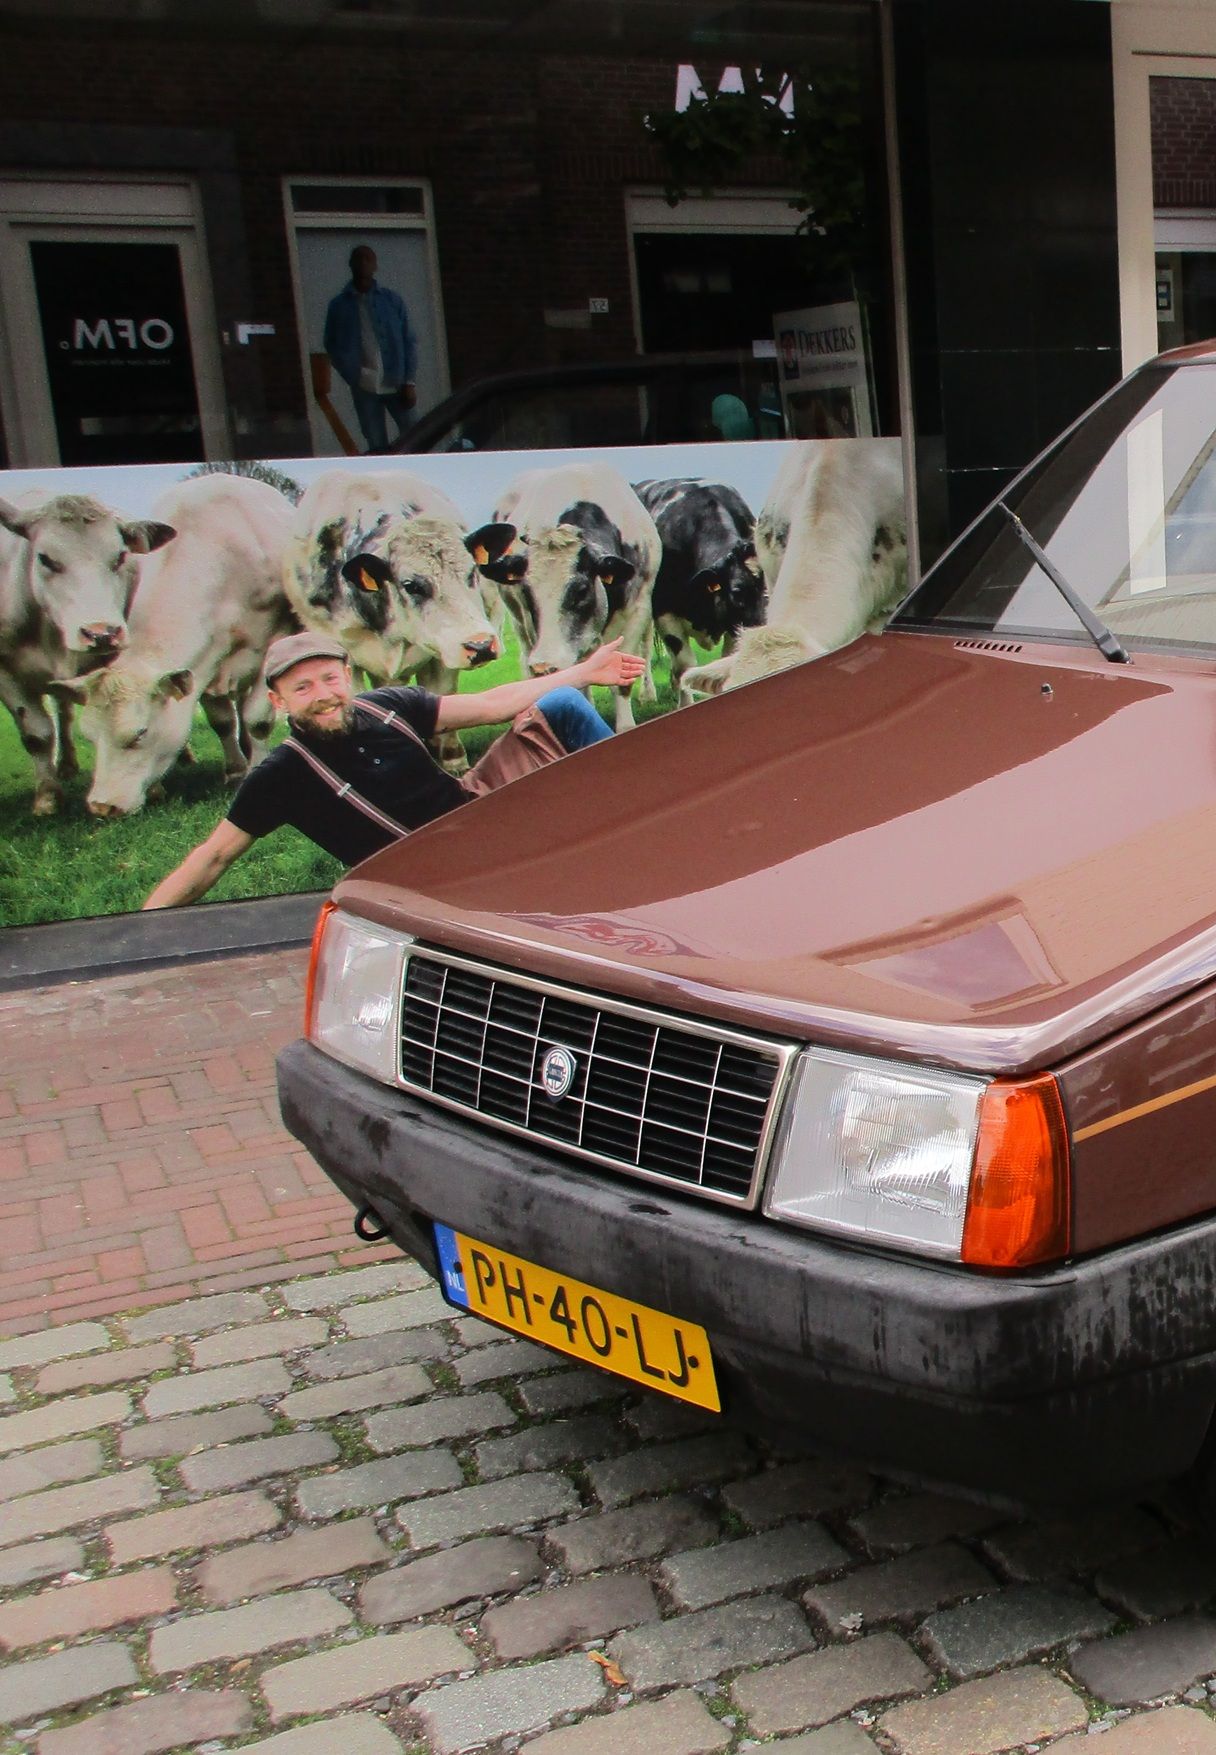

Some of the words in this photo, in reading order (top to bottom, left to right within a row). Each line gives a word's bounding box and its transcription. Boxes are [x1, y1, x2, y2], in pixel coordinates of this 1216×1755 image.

[798, 326, 857, 358] DEKKERS
[446, 1269, 465, 1293] NL
[470, 1248, 690, 1388] PH-40-LJ
